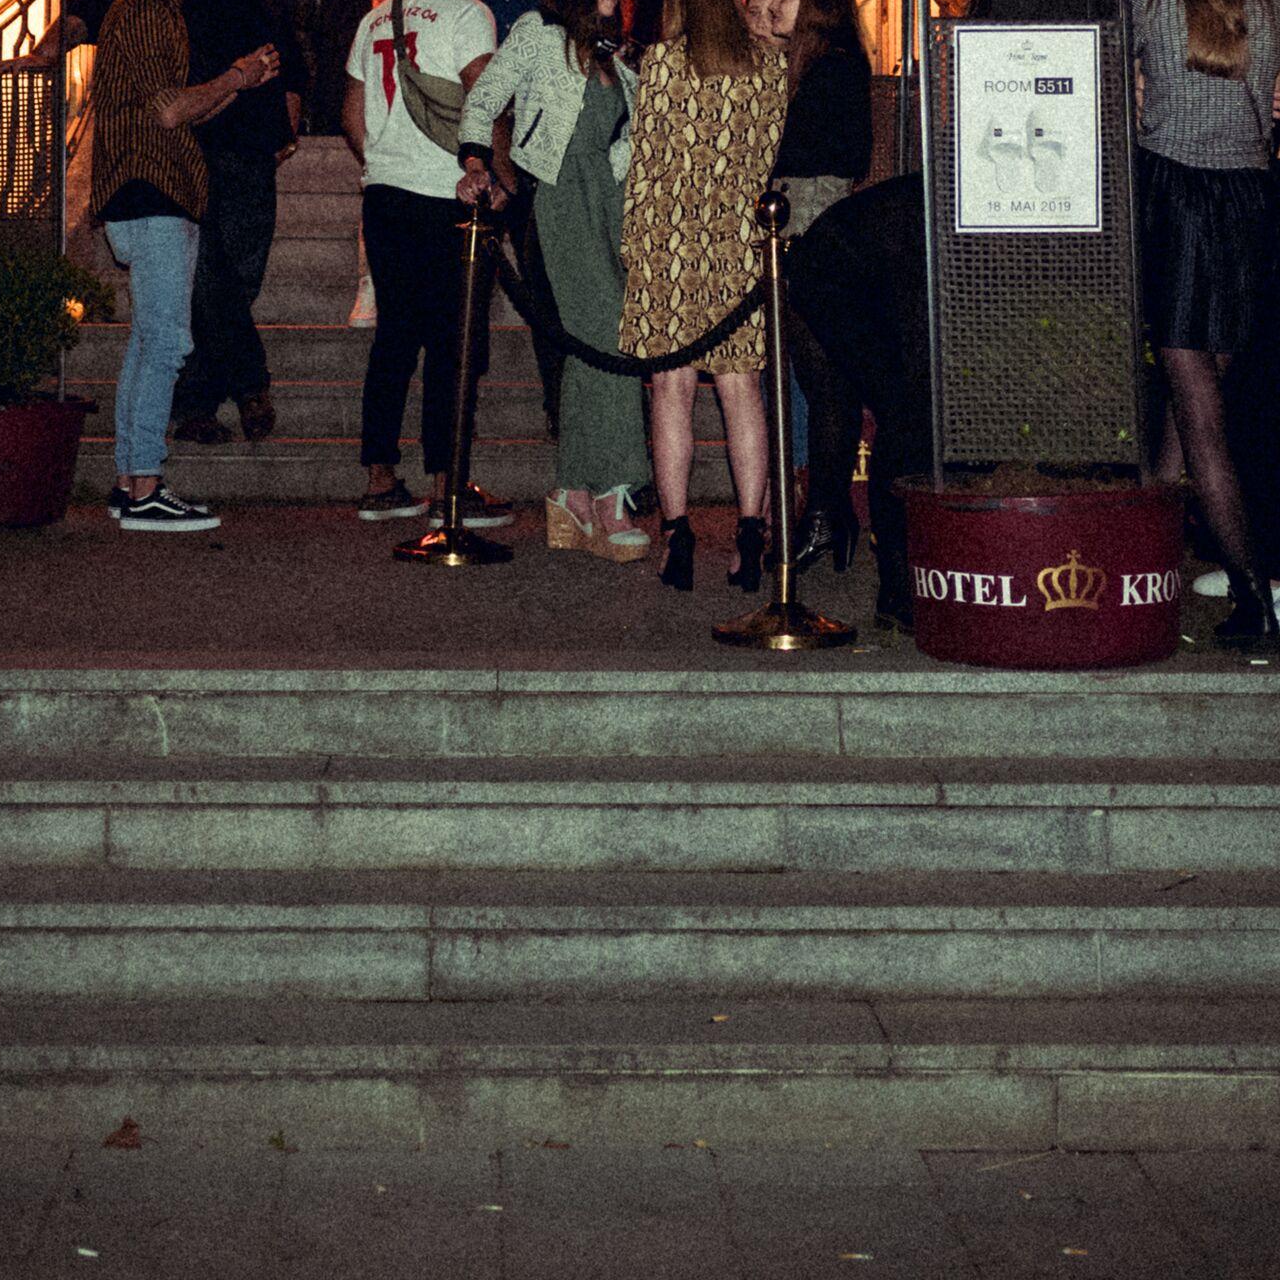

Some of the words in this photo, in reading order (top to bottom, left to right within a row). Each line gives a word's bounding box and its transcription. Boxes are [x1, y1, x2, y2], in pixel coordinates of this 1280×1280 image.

[984, 80, 1032, 93] ROOM
[1037, 80, 1070, 93] 5511
[987, 201, 1005, 212] 18.
[1010, 201, 1035, 212] MAI
[1040, 201, 1071, 212] 2019
[913, 566, 1027, 607] HOTEL
